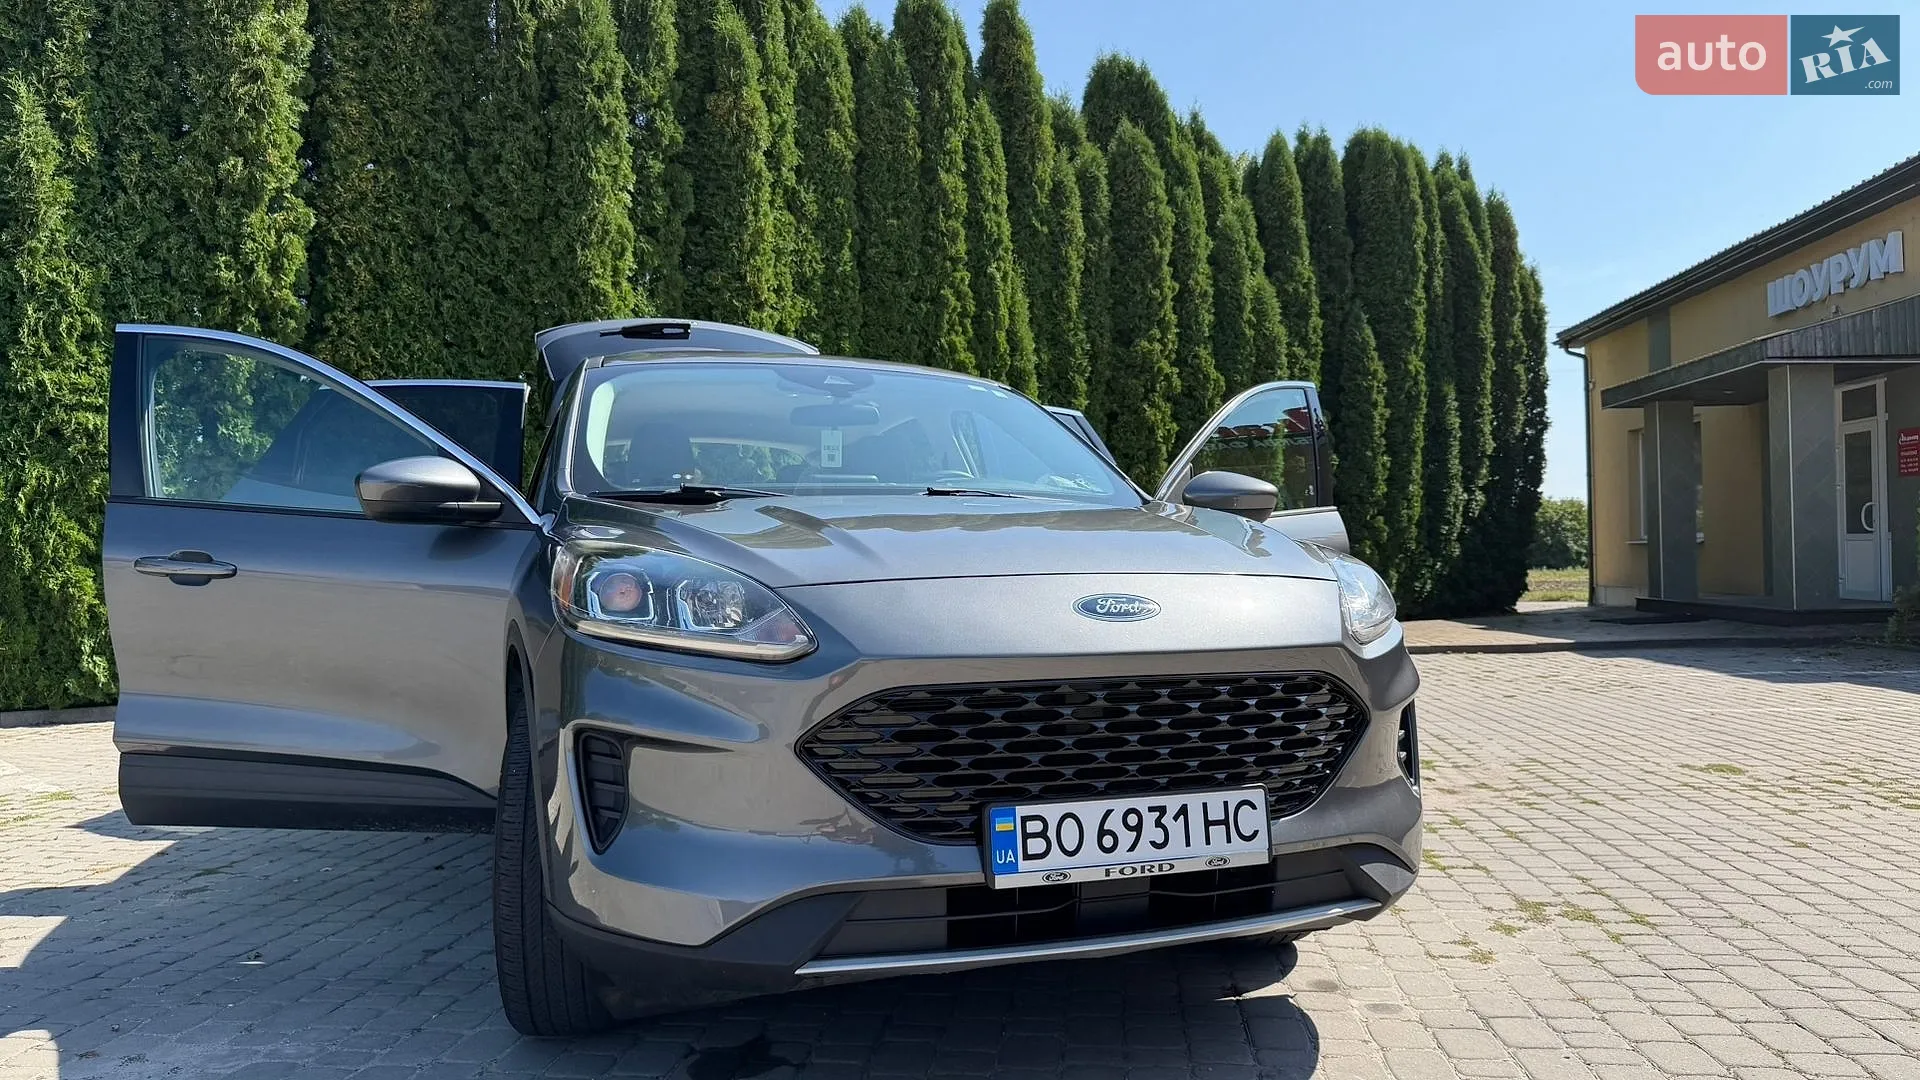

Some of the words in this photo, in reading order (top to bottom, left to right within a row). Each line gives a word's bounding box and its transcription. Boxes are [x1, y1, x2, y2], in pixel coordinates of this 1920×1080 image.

[1767, 230, 1905, 317] ШОУРУМ
[1096, 597, 1141, 614] Ford
[1020, 812, 1085, 861] BO
[1096, 803, 1192, 854] 6931
[1202, 799, 1260, 846] HC
[996, 849, 1016, 865] UA
[1104, 862, 1175, 878] FORD
